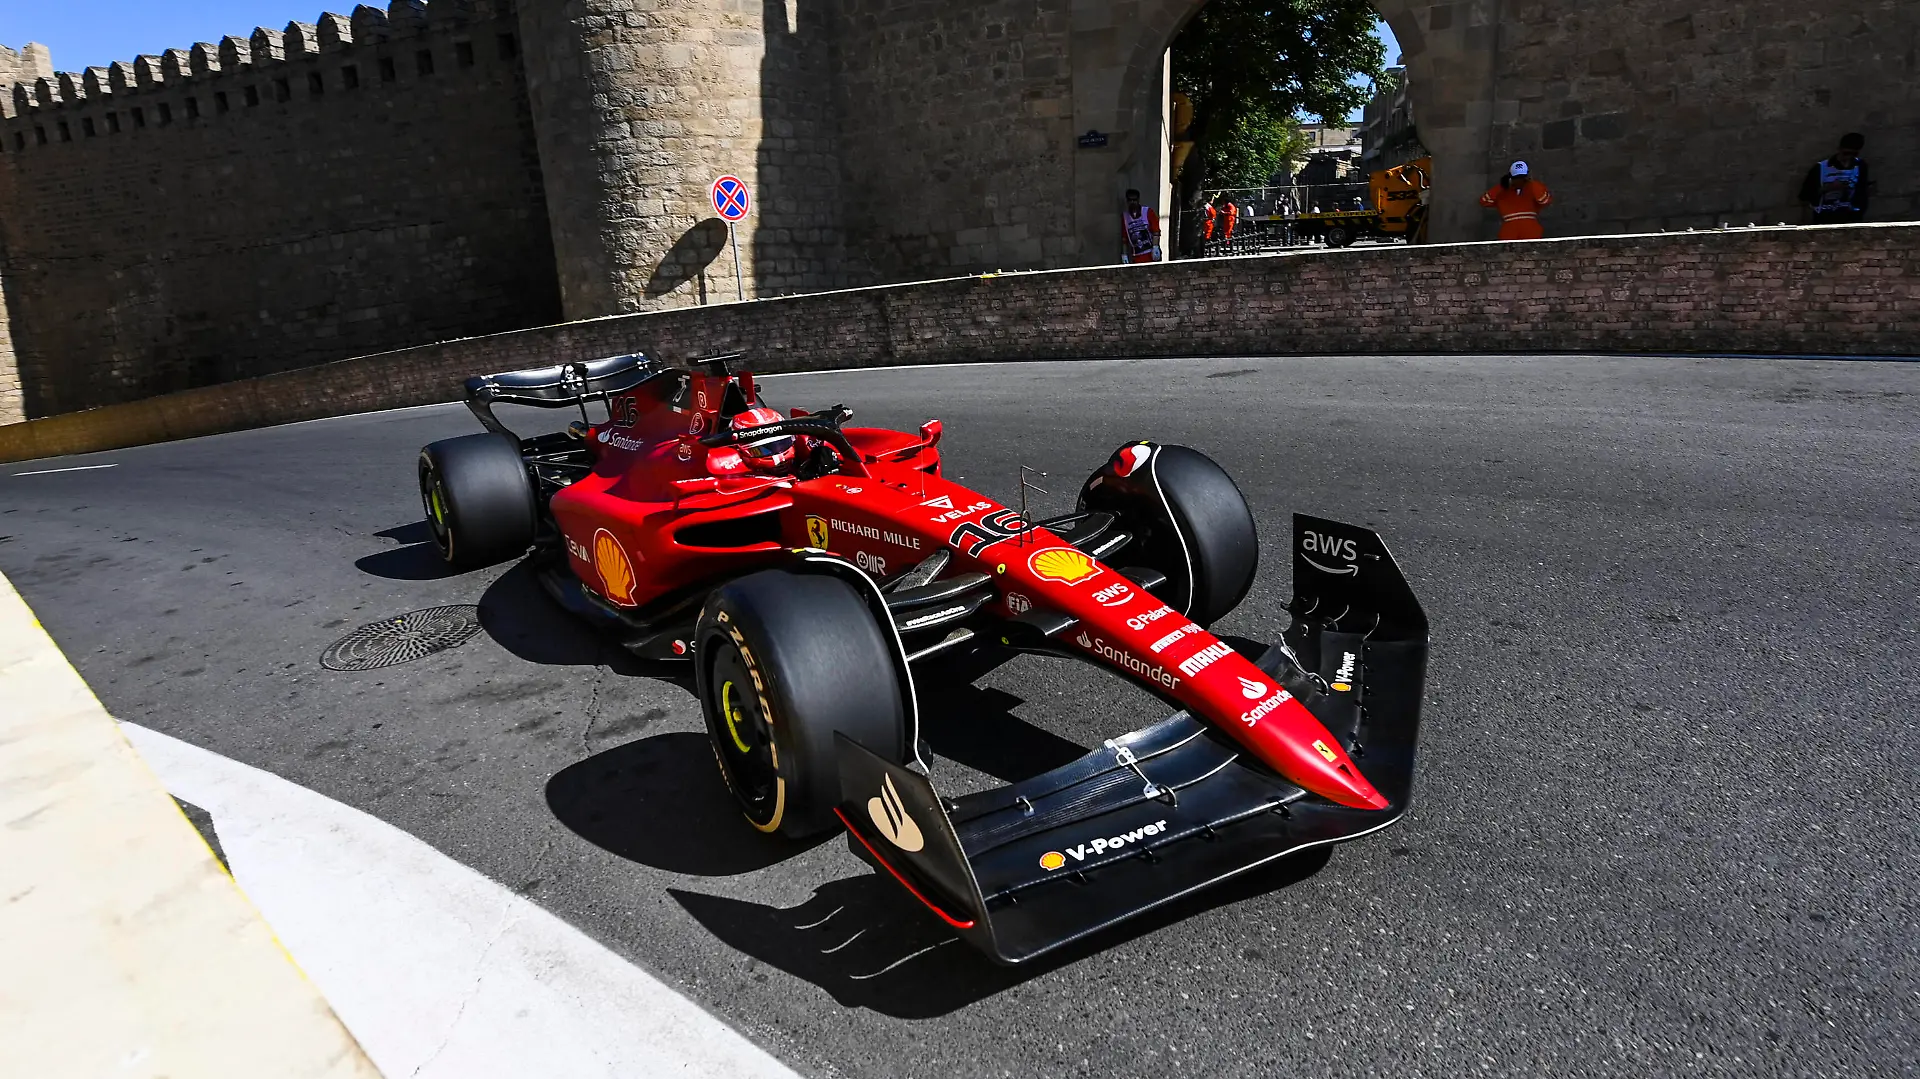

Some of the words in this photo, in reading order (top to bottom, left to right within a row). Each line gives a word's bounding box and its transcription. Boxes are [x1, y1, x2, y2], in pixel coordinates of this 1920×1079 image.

[613, 396, 640, 429] 16
[739, 424, 783, 439] Snapdragon
[679, 443, 692, 456] aws
[930, 501, 992, 523] VELAS
[830, 518, 880, 540] RICHARD
[883, 530, 921, 550] MILLE
[949, 508, 1041, 559] 16
[1302, 530, 1357, 561] aws
[1091, 582, 1129, 603] aws
[717, 610, 730, 623] P
[729, 625, 774, 725] ZERO
[1094, 637, 1181, 690] Santander
[1334, 651, 1357, 683] V-Power
[1064, 819, 1168, 862] V-Power
